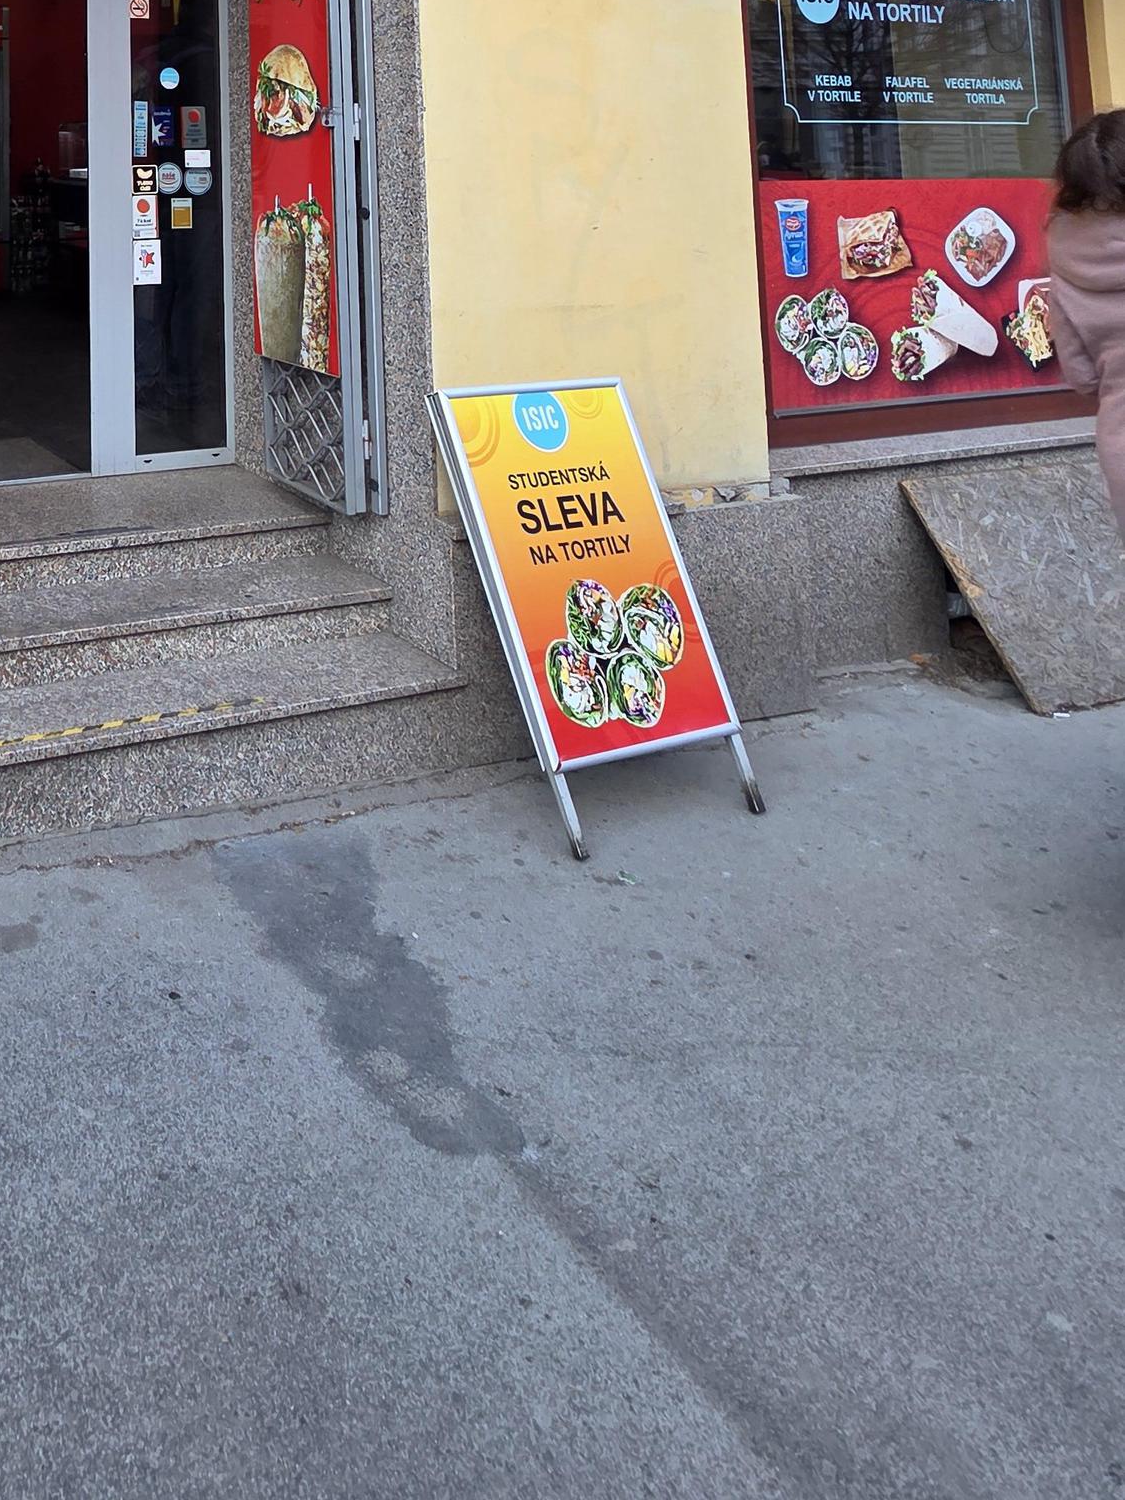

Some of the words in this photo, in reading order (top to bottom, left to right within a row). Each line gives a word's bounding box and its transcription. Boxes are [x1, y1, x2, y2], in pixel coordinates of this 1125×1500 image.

[848, 2, 873, 21] NA
[876, 3, 945, 25] TORTILY
[814, 74, 852, 87] KEBAB
[885, 76, 930, 88] FALAFEL
[944, 75, 1023, 91] VEGETARIÁNSKÁ
[808, 89, 816, 102] V
[817, 89, 861, 102] TORTILE
[883, 90, 891, 102] V
[892, 90, 934, 103] TORTILE
[965, 92, 1006, 104] TORTILA
[523, 404, 560, 432] ISIC
[507, 460, 611, 491] STUDENTSKÁ
[516, 490, 626, 535] SLEVA
[529, 544, 558, 566] NA
[558, 534, 632, 562] TORTILY
